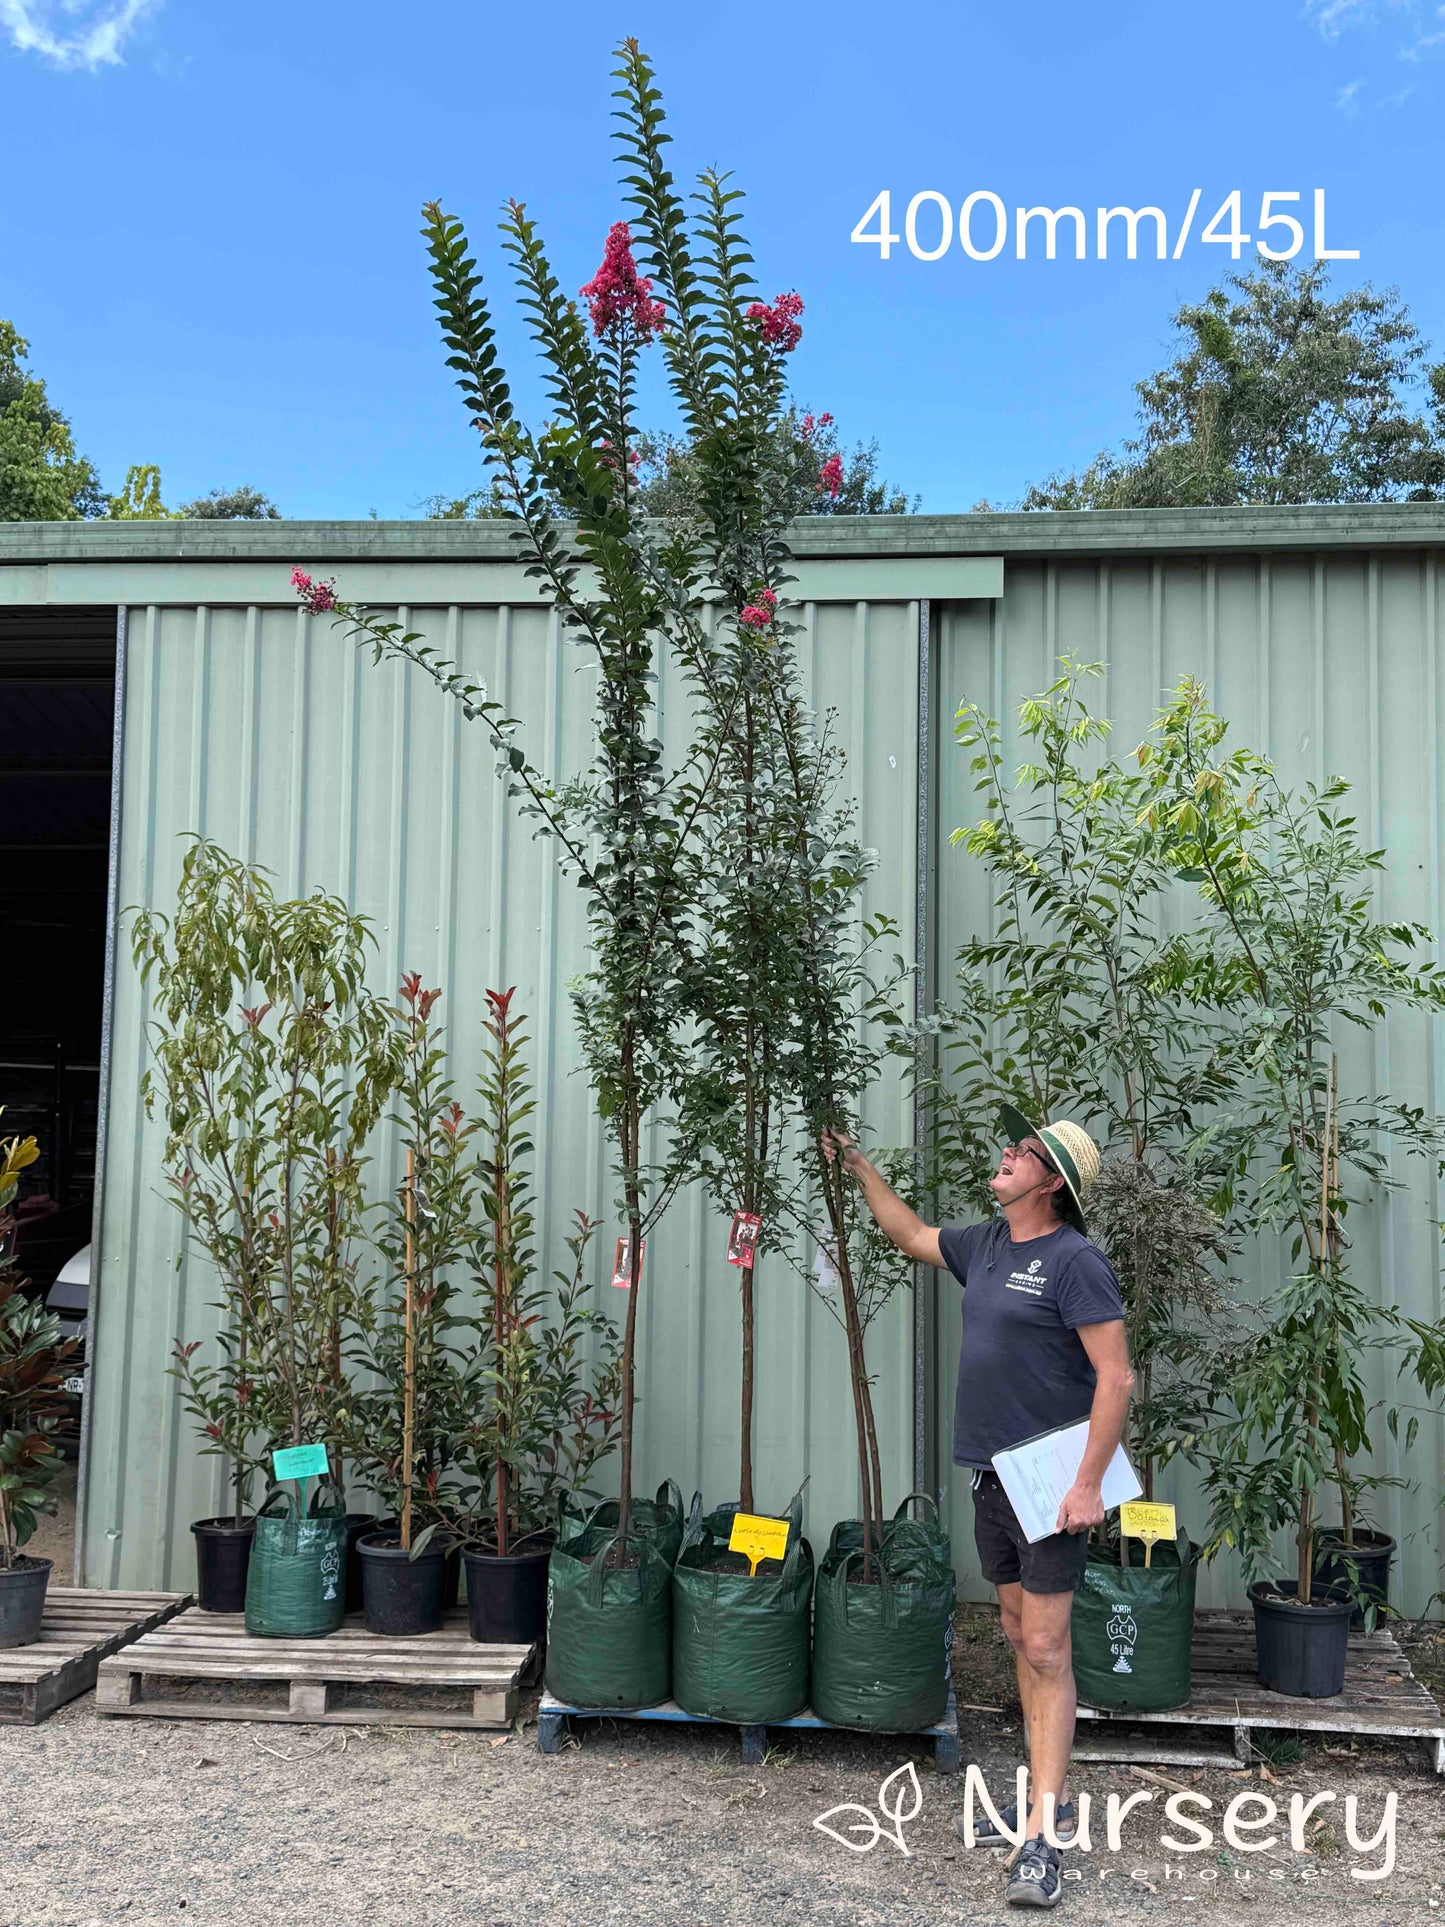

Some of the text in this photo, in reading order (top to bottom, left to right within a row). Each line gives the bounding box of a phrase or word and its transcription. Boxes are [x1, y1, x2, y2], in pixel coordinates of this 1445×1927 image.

[1010, 1272, 1047, 1285] INSTANT
[1111, 1604, 1132, 1614] NORTH
[1110, 1623, 1135, 1636] GCP
[1110, 1643, 1134, 1656] 45 Litre
